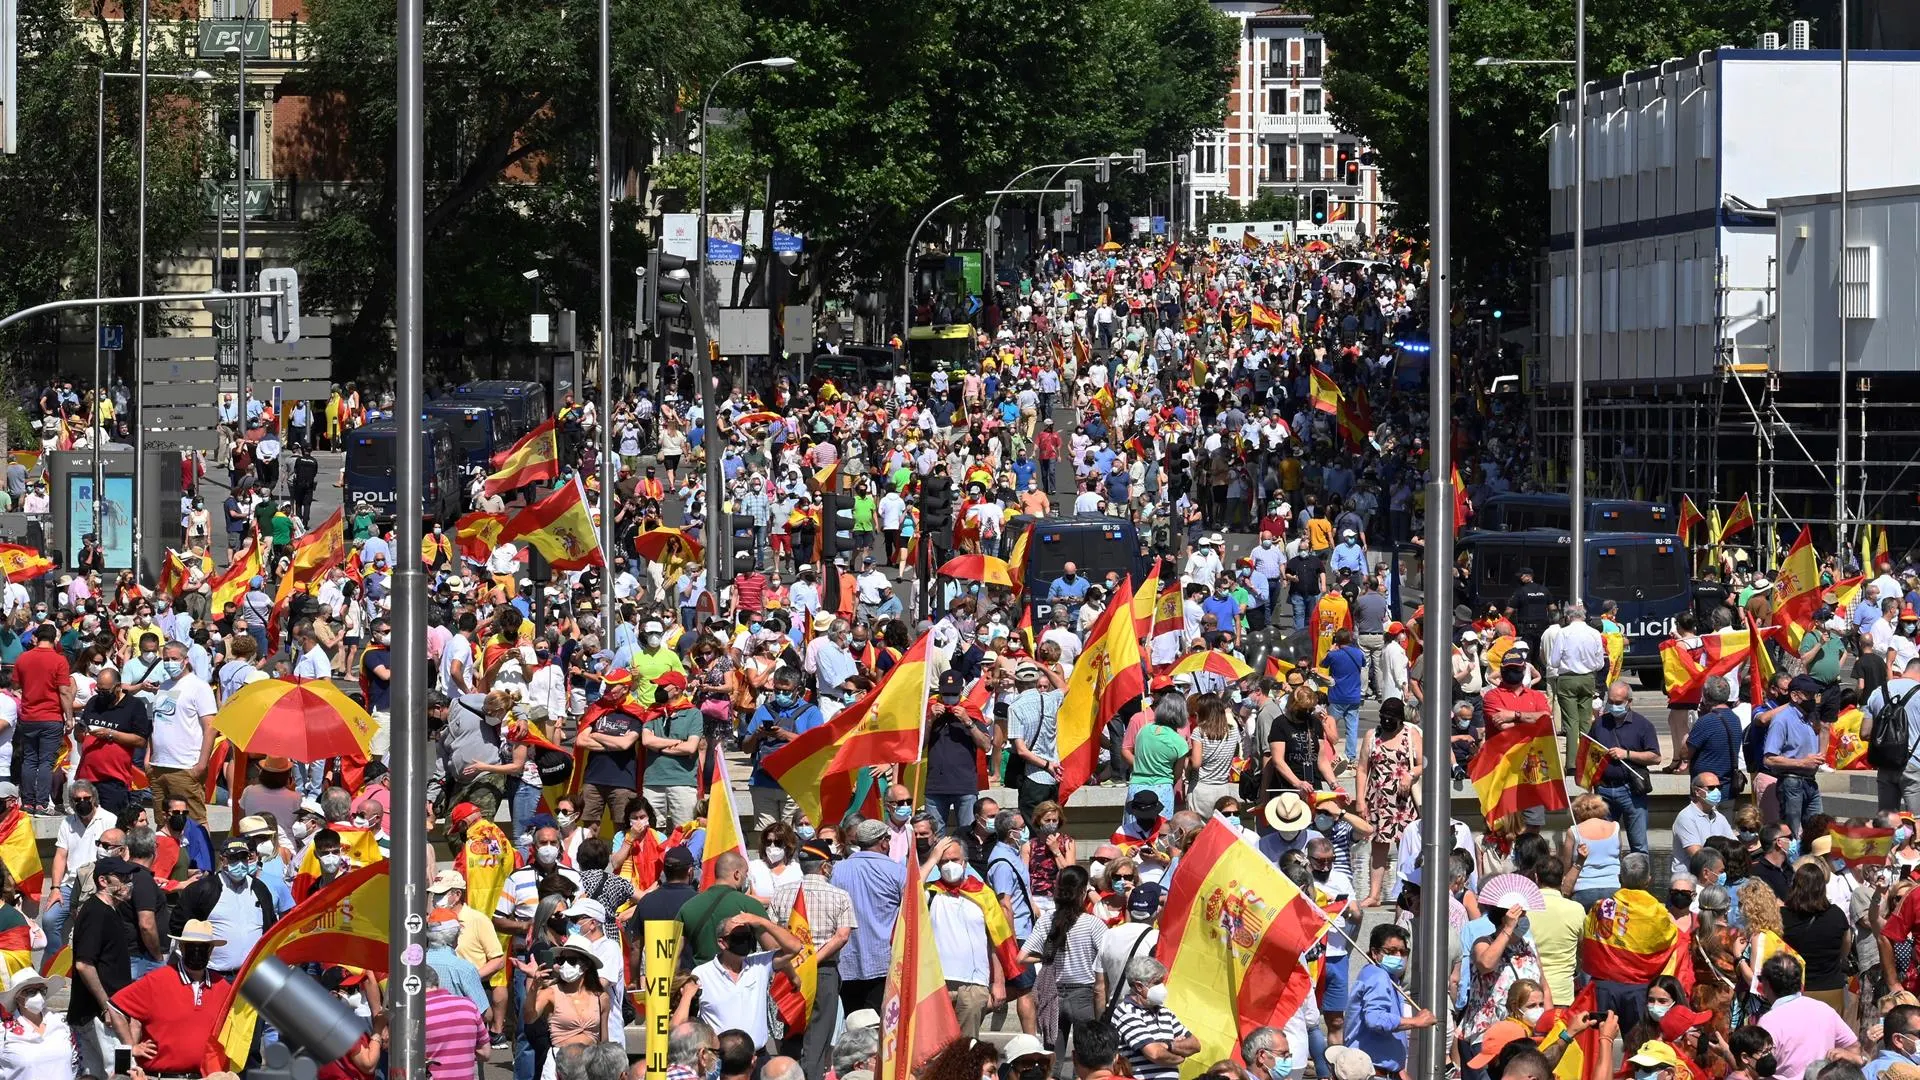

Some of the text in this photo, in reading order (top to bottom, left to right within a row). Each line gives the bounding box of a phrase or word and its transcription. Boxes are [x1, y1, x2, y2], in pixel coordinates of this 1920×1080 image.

[215, 31, 255, 46] PSN
[105, 328, 115, 347] P
[89, 719, 119, 729] TOMMY
